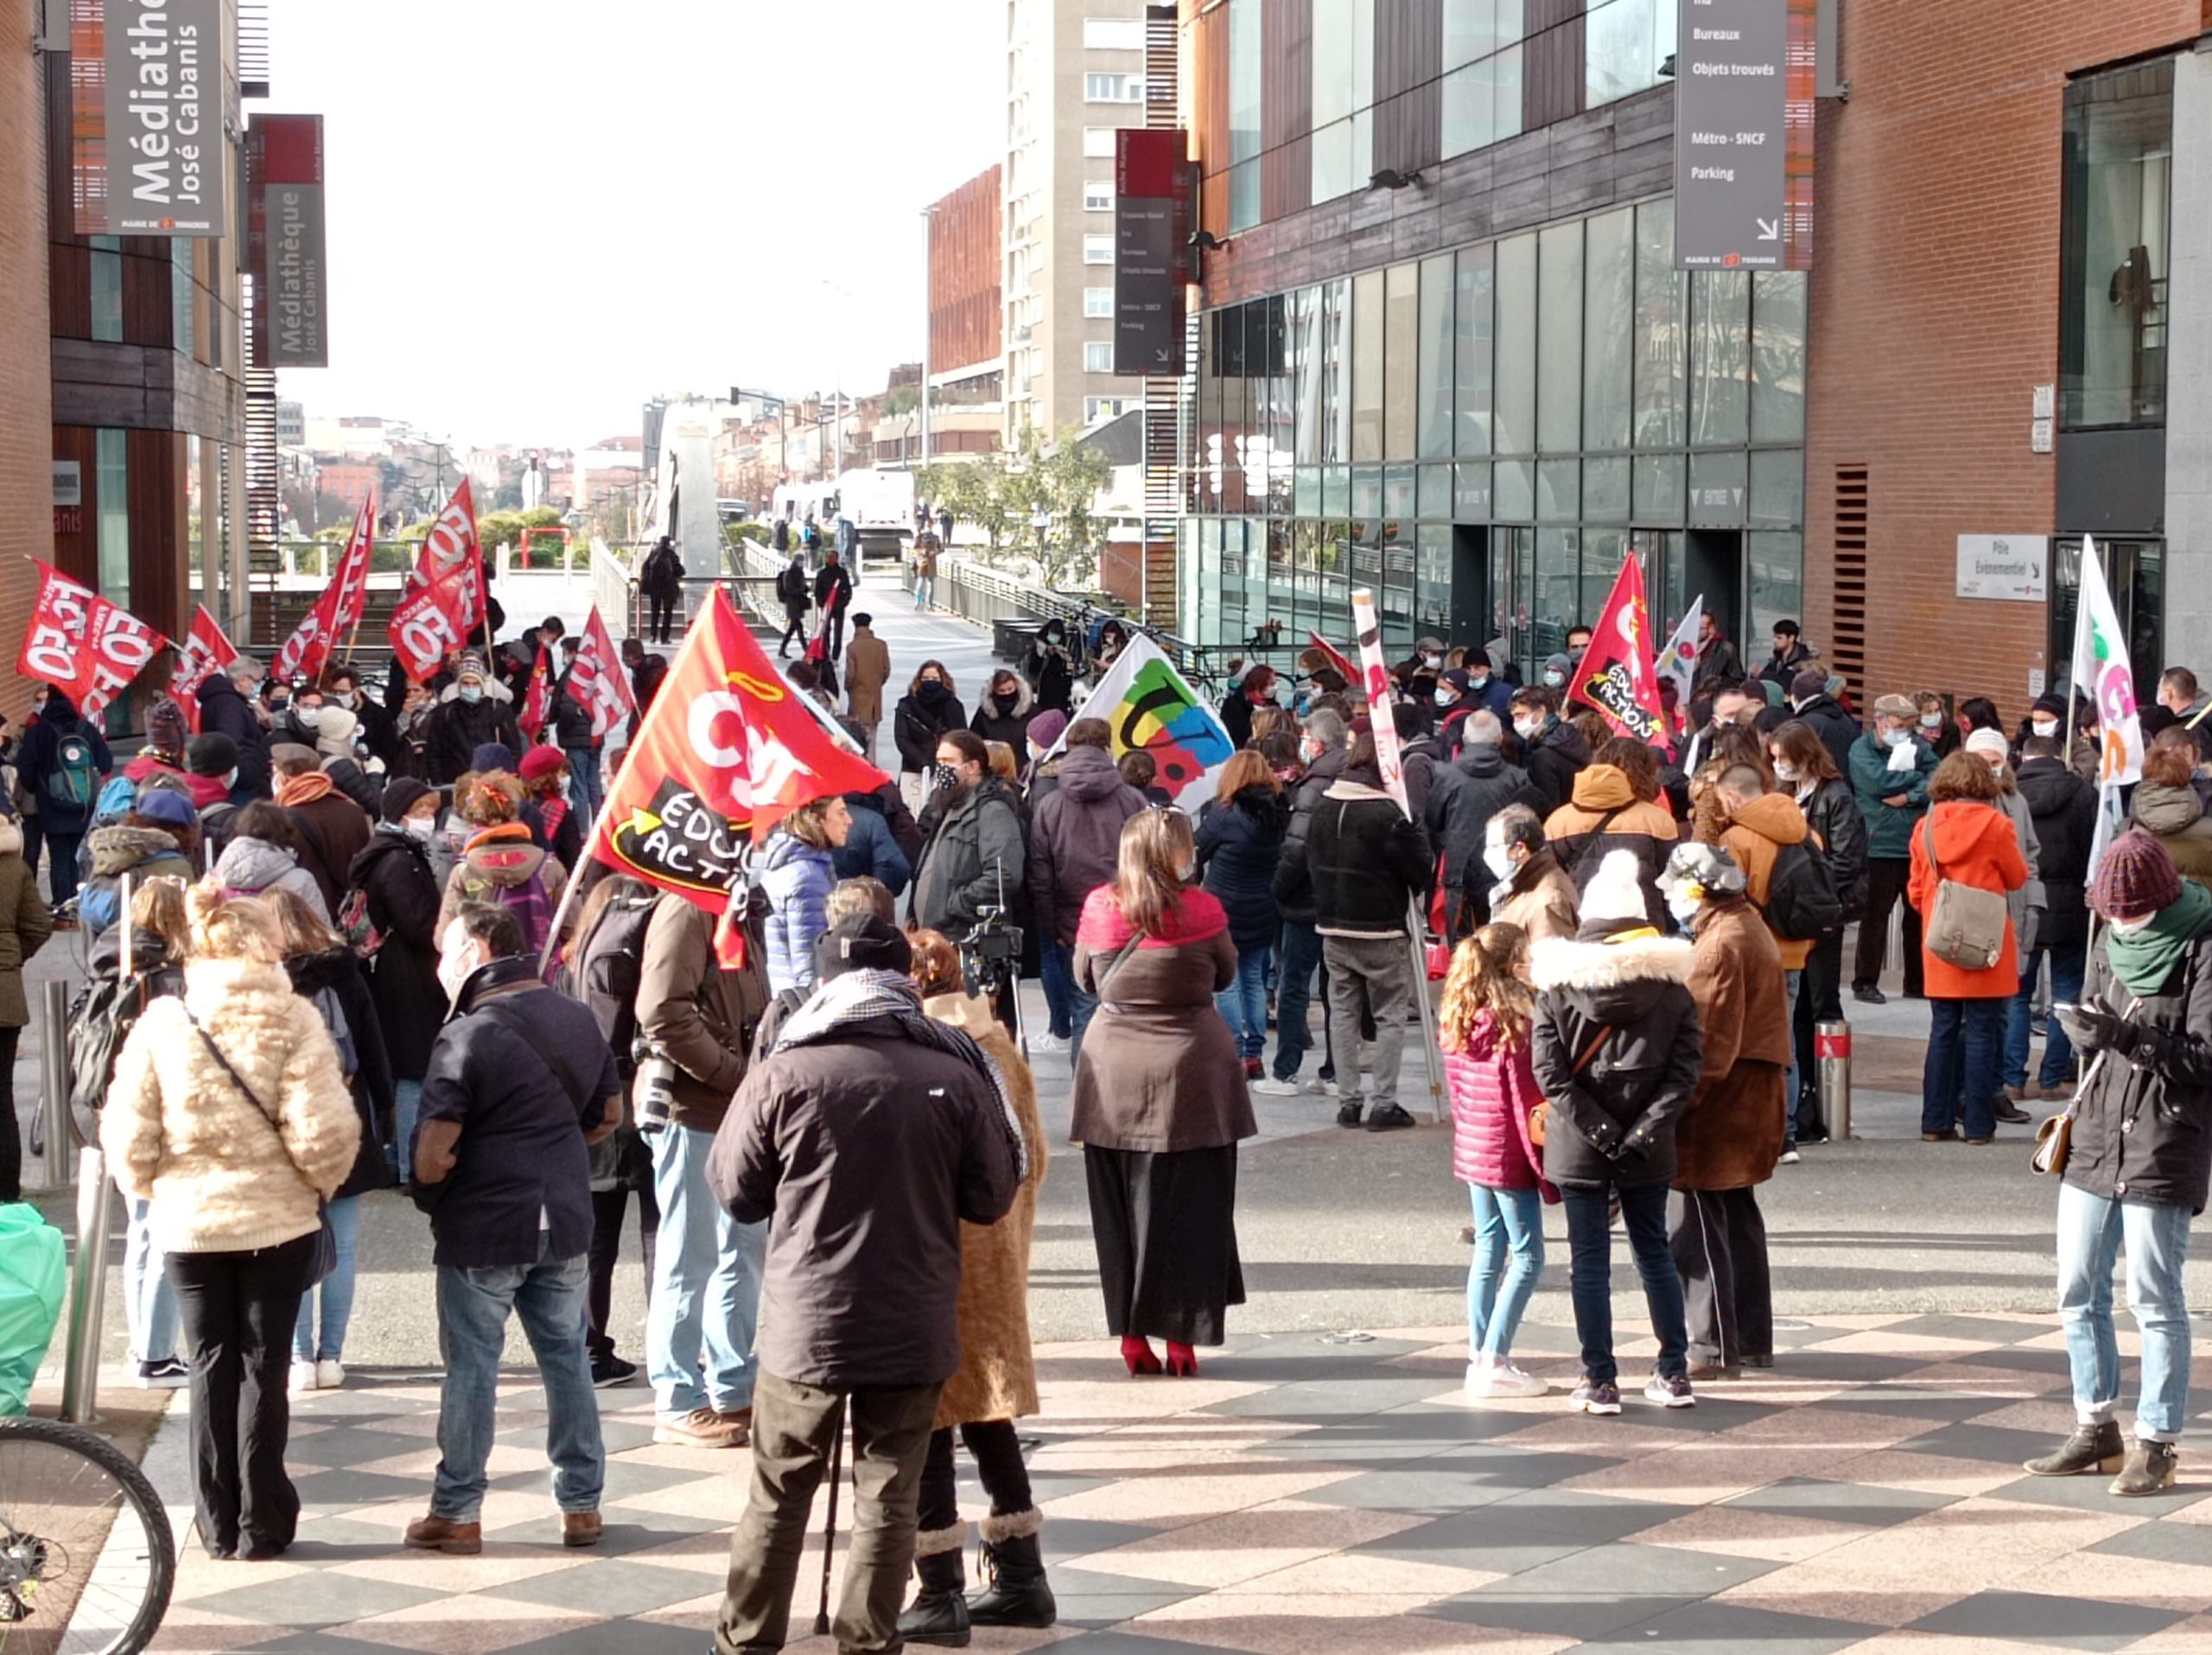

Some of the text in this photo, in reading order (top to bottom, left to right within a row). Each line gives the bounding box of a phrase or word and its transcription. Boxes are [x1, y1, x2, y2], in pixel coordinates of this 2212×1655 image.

[1693, 28, 1740, 40] Bureaux
[1692, 62, 1775, 77] Objets trouvés
[173, 24, 200, 205] José Cabanis
[1691, 132, 1727, 144] Métro
[1736, 133, 1766, 145] SNCF
[1691, 167, 1734, 181] Parking
[278, 192, 305, 353] Médiathèque
[303, 259, 317, 353] José Cabanis
